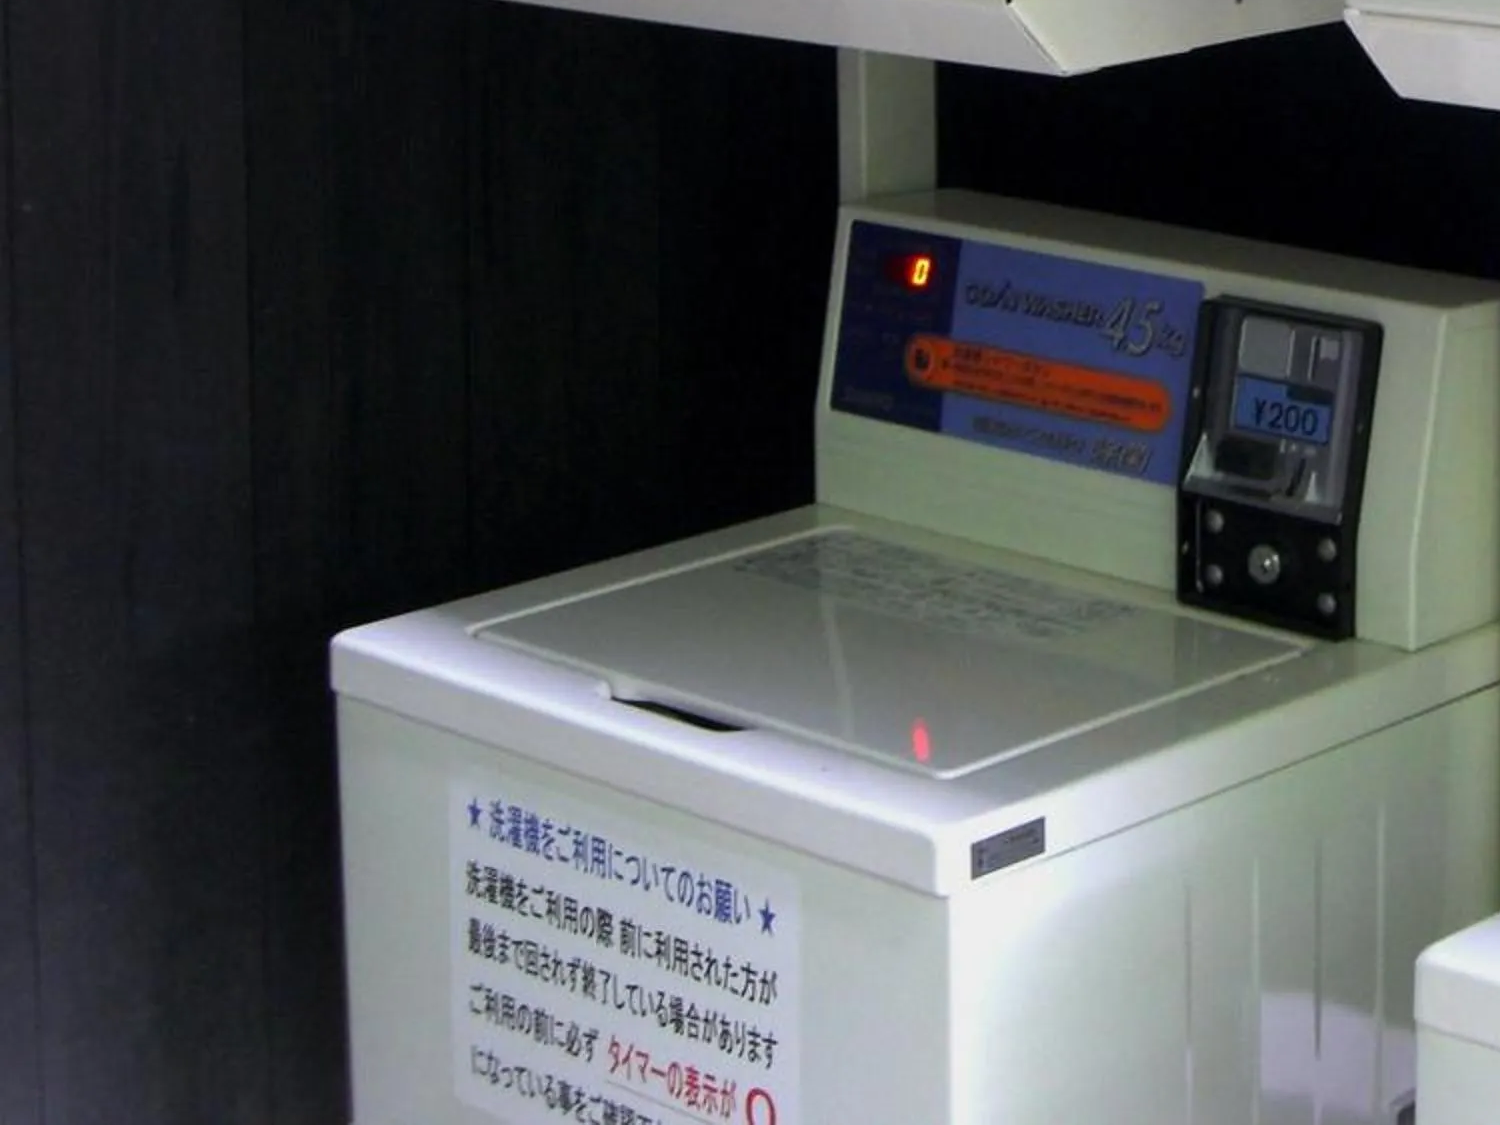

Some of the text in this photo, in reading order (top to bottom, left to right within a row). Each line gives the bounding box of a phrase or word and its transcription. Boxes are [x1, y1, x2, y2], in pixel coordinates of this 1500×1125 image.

[911, 257, 930, 287] 0
[1255, 396, 1319, 436] ¥200
[489, 799, 752, 926] 洗濯機をご利用についてのお願い
[468, 916, 779, 1071] 最後まで回されず終了している場合があります
[619, 918, 779, 1007] 前に利用された方が
[469, 981, 600, 1064] ご利用の前に必ず
[607, 1033, 737, 1118] タイマーの表示が
